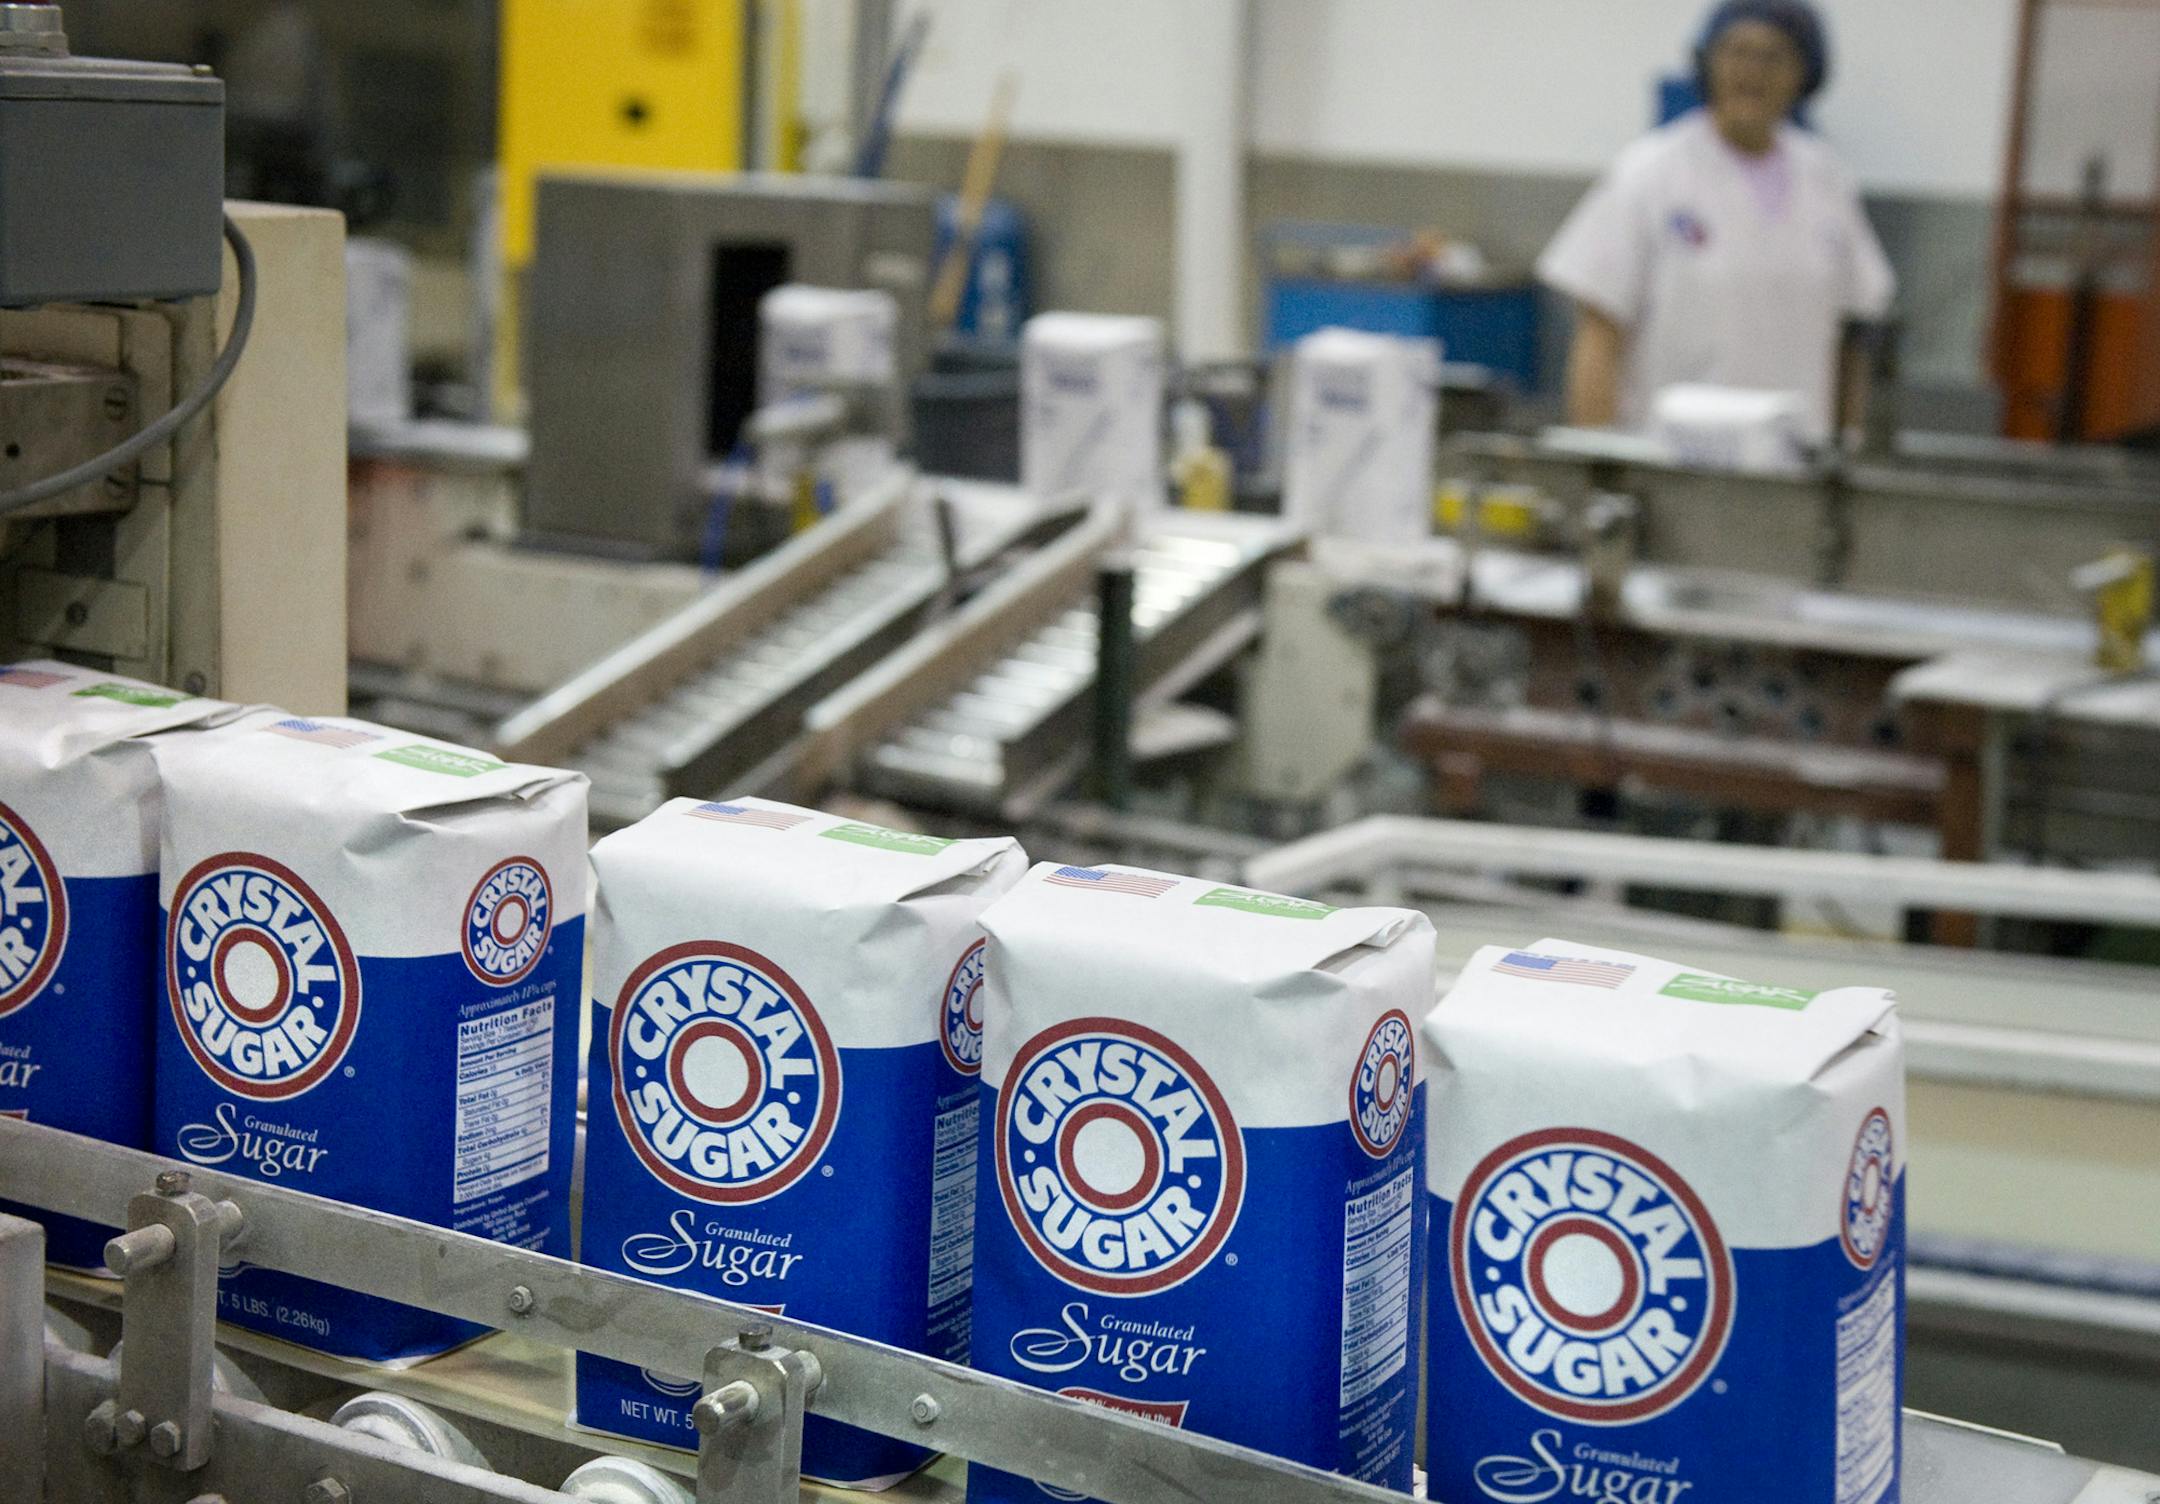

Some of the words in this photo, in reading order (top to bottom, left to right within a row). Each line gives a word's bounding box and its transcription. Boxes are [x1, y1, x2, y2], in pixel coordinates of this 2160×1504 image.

[472, 867, 547, 918] CRYSTAL
[179, 874, 337, 995] CRYSTAL
[474, 922, 543, 974] SUGAR
[183, 981, 328, 1076] SUGAR
[460, 1014, 518, 1036] Nutrition
[522, 1001, 552, 1020] Facts
[627, 964, 815, 1090] CRYSTAL
[459, 1067, 489, 1080] Calories
[1360, 1021, 1410, 1093] CRYSTAL
[177, 1102, 328, 1177] Sugar
[244, 1115, 318, 1142] Granulated
[630, 1081, 805, 1178] SUGAR
[1014, 1042, 1217, 1174] CRYSTAL
[1361, 1084, 1408, 1143] SUGAR
[1019, 1166, 1207, 1269] SUGAR
[1347, 1189, 1391, 1216] Nutrition
[1392, 1172, 1412, 1194] Facts
[1474, 1153, 1705, 1295] CRYSTAL
[621, 1209, 803, 1286] Sugar
[705, 1222, 792, 1248] Granulated
[231, 1293, 241, 1309] 5
[243, 1295, 273, 1318] LBS.
[275, 1306, 331, 1337] (2.26kg)
[1010, 1302, 1206, 1383] Sugar
[1100, 1314, 1195, 1341] Granulated
[1479, 1284, 1693, 1396] SUGAR
[620, 1398, 650, 1420] NET
[653, 1406, 681, 1428] WT.
[685, 1413, 695, 1430] 5
[1473, 1428, 1693, 1504] Sugar
[1573, 1442, 1680, 1475] Granulated
